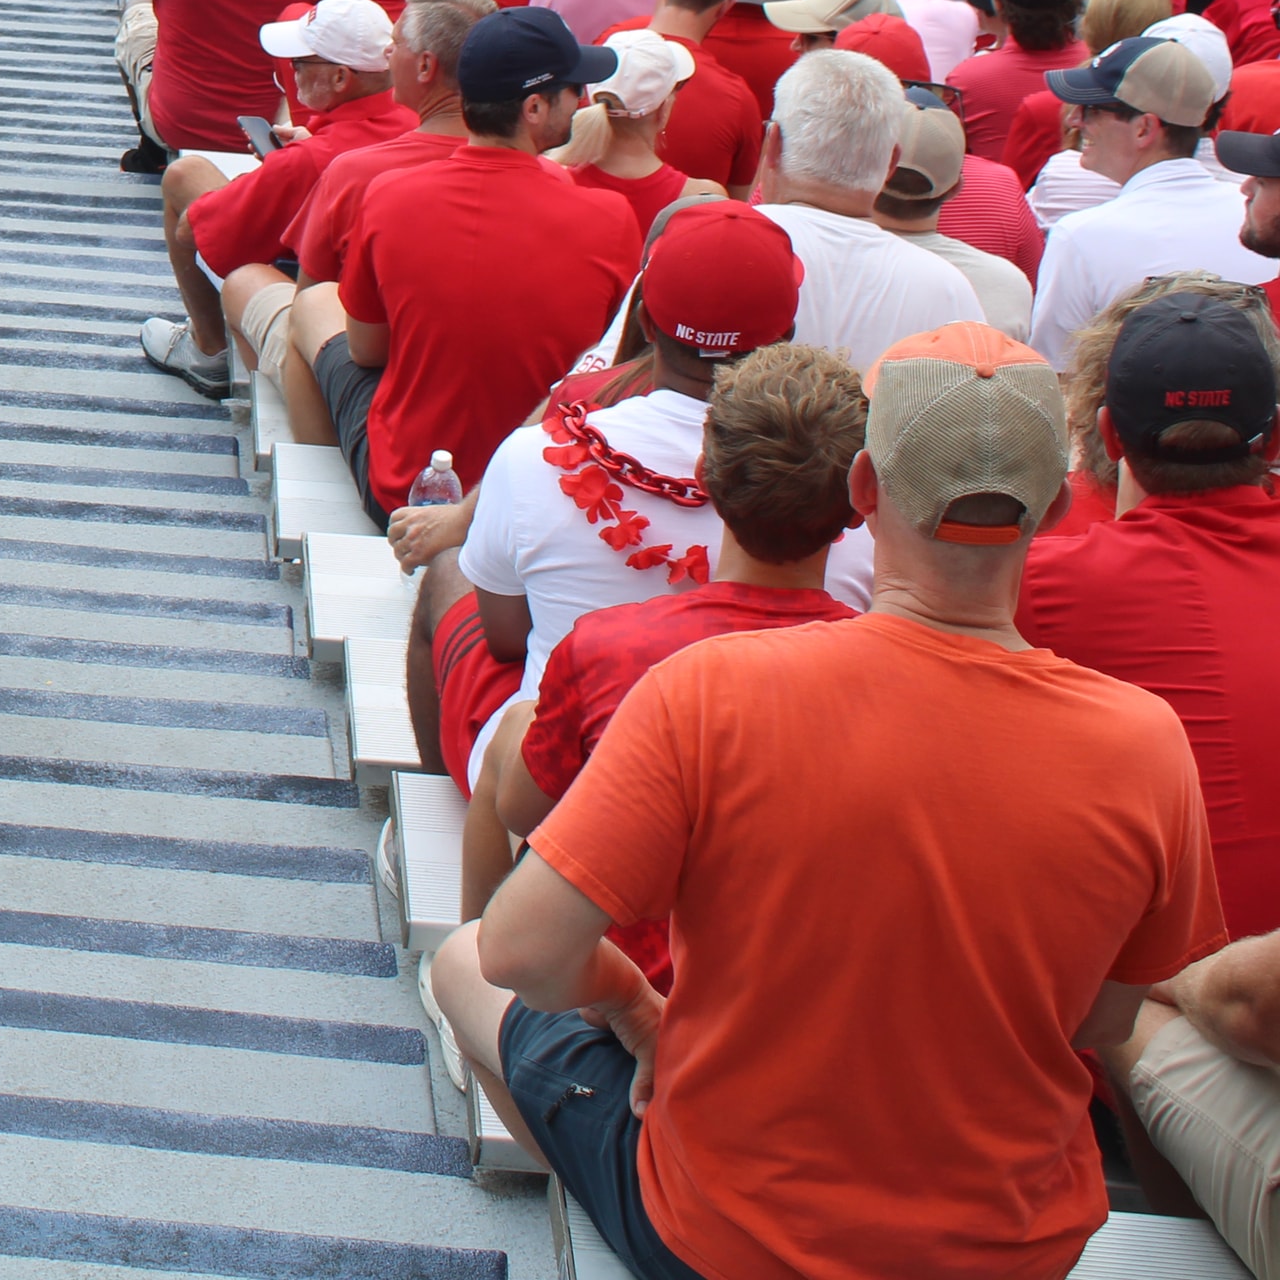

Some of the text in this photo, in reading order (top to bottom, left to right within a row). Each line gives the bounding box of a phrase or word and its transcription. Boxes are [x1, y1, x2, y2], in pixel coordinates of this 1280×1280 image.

[675, 322, 742, 346] NC STATE
[1164, 388, 1233, 407] NC STATE
